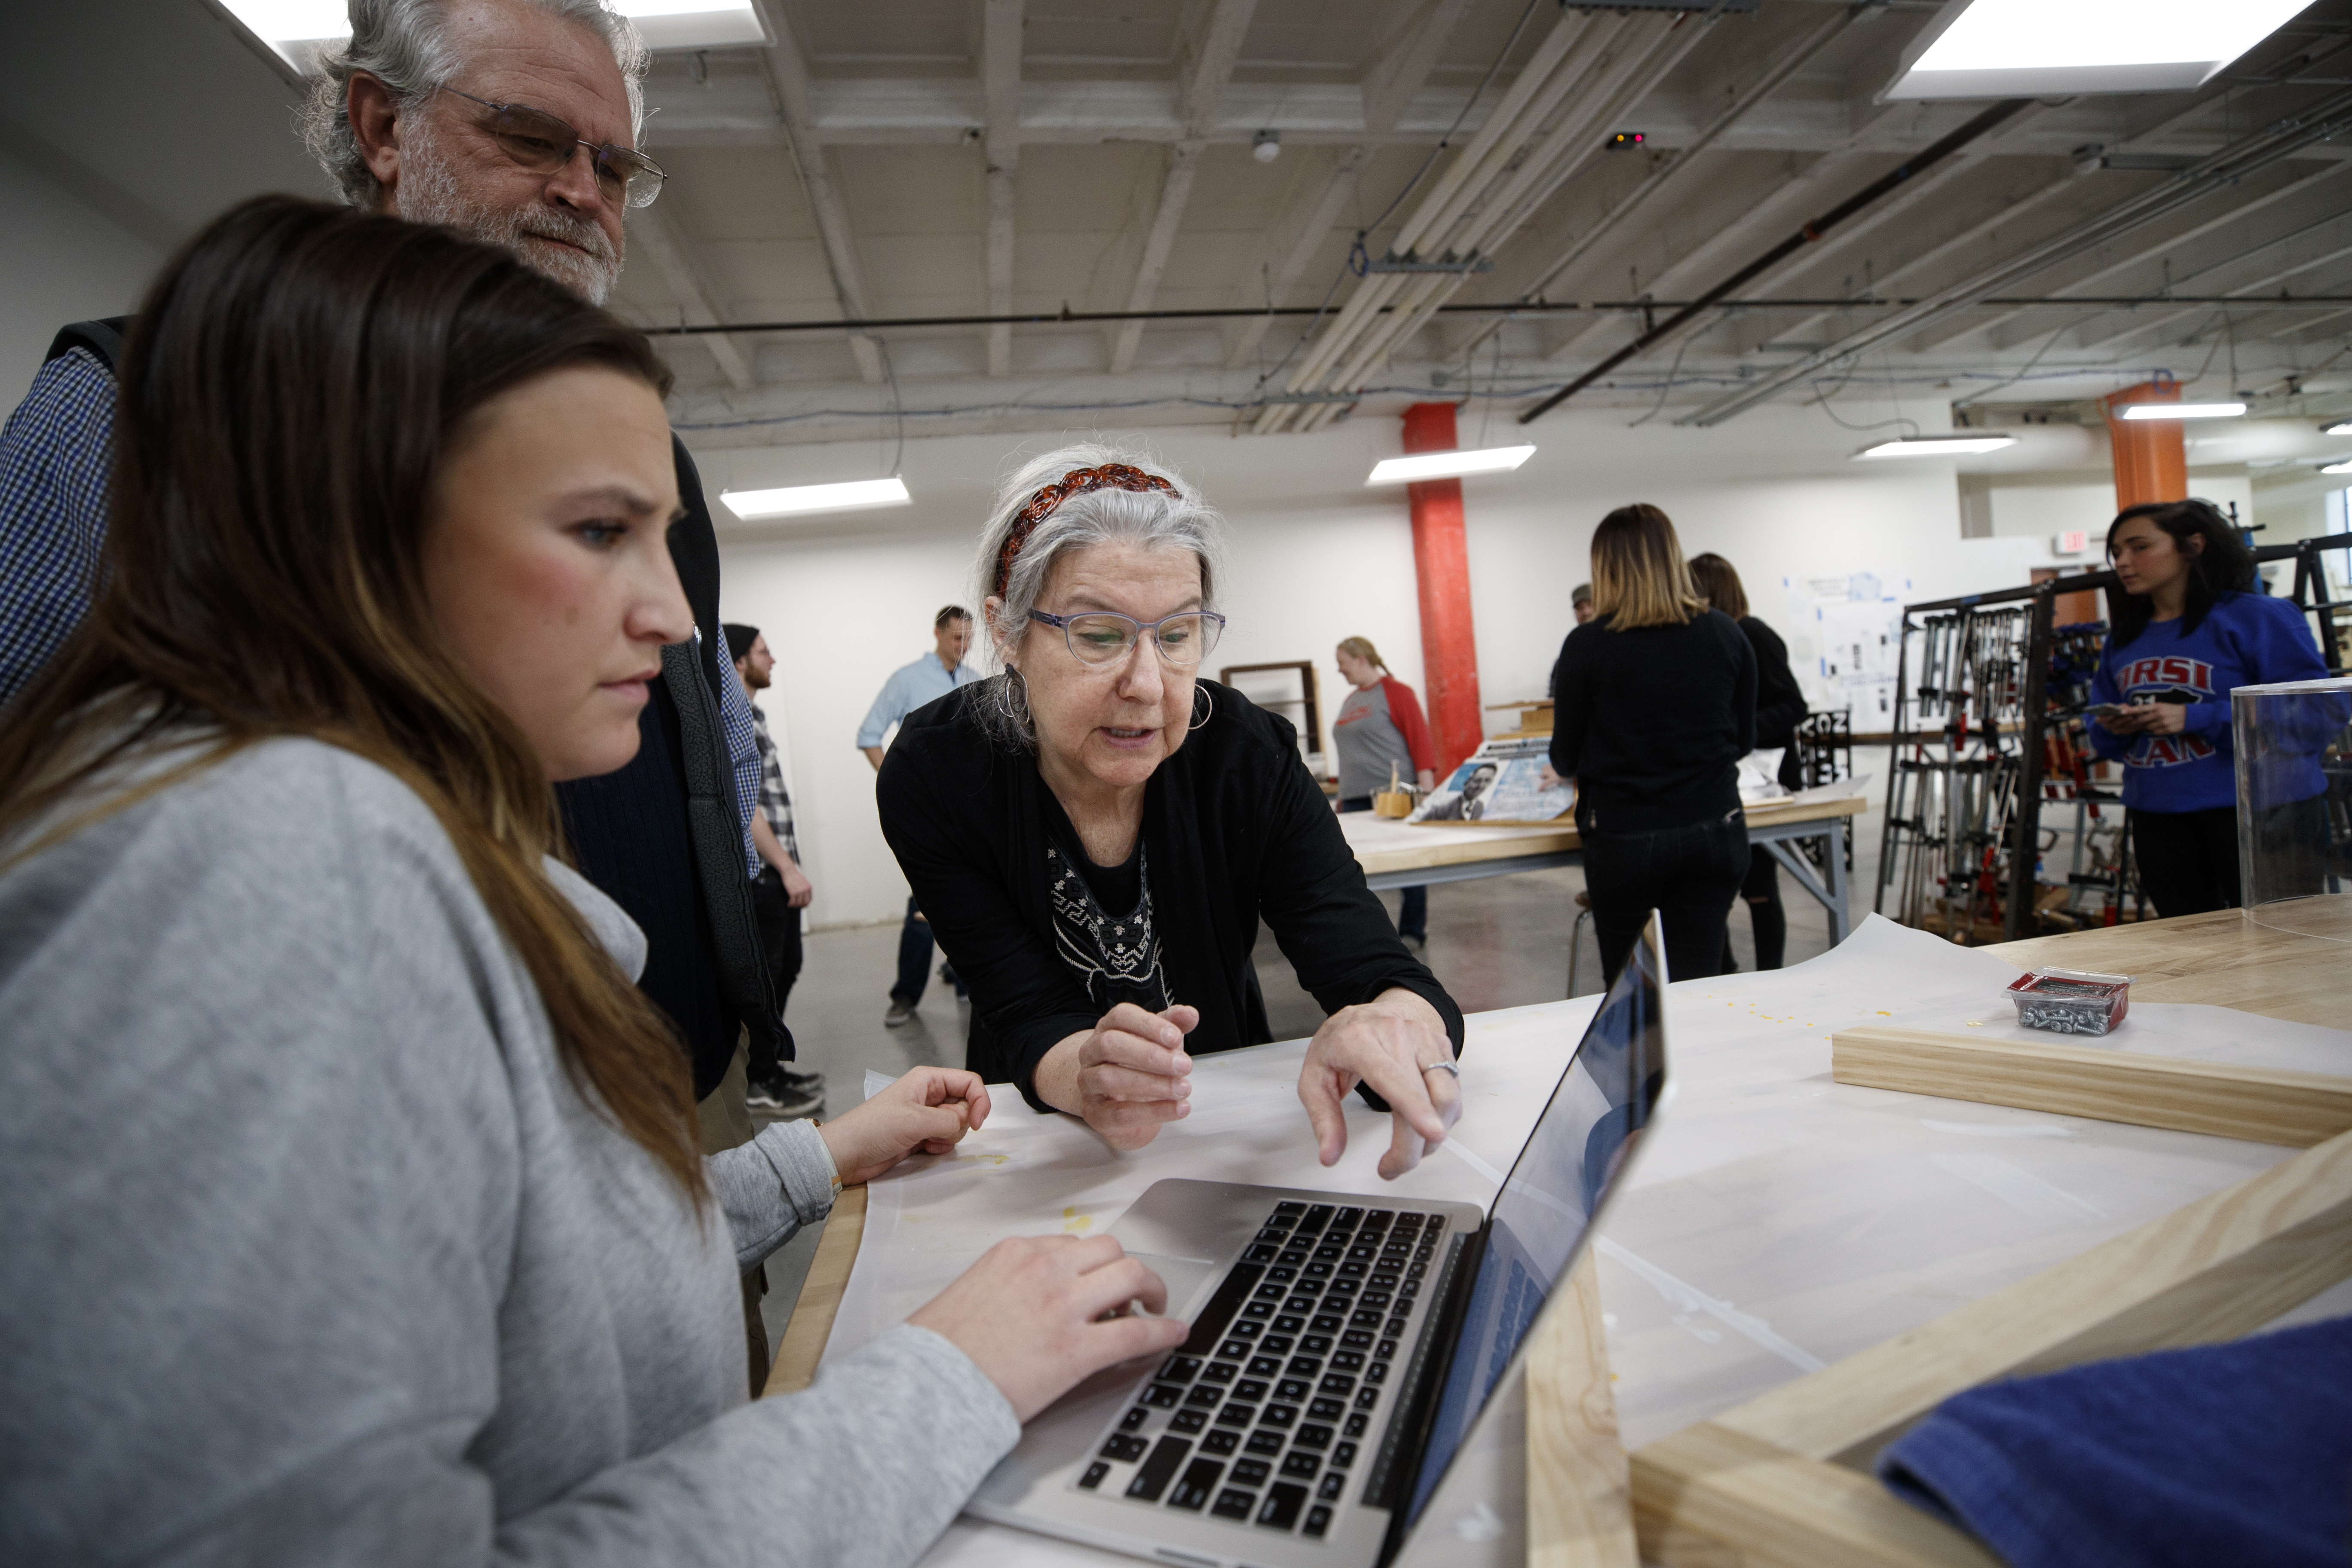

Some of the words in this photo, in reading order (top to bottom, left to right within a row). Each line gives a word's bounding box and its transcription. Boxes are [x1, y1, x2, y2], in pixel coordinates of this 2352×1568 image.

[2065, 530, 2086, 552] EXIT
[1313, 1265, 1324, 1273] D
[1282, 1319, 1293, 1328] H
[1240, 1324, 1253, 1333] N
[1308, 1339, 1321, 1348] U
[1227, 1343, 1240, 1354] M
[1257, 1361, 1269, 1370] K
